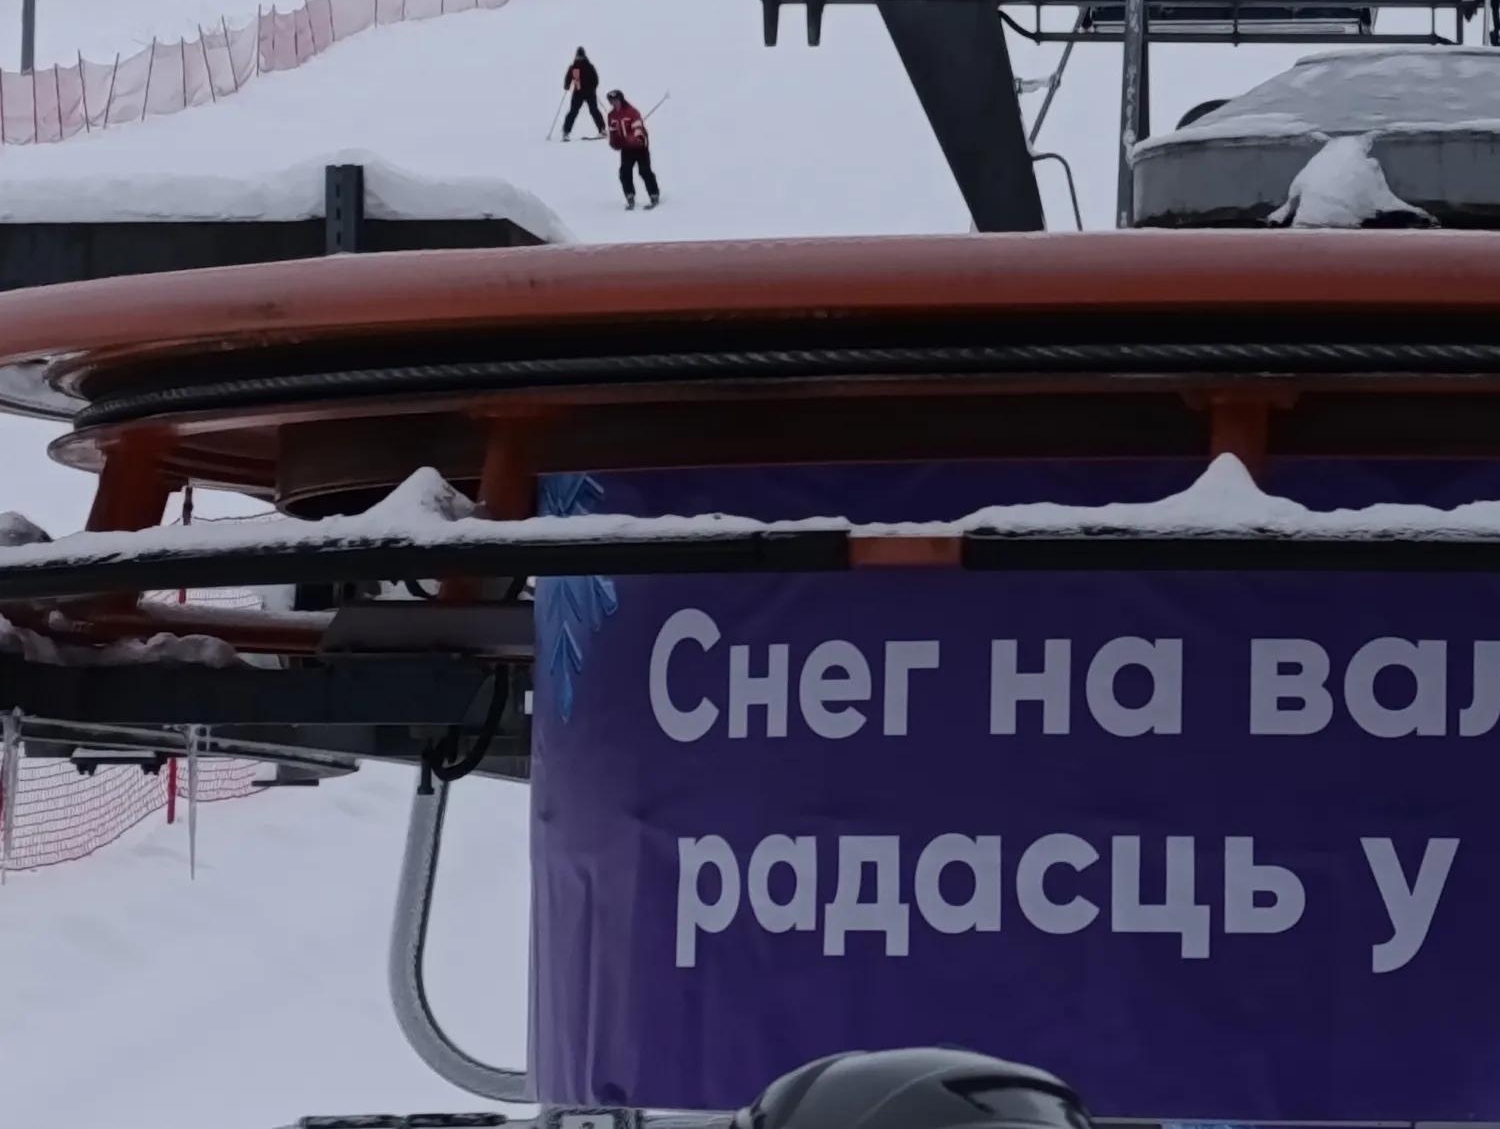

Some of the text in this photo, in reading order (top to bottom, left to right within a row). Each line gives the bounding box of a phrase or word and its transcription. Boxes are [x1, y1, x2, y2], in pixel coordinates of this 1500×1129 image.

[650, 608, 940, 742] Снег
[990, 636, 1183, 737] на
[675, 832, 1306, 968] радасць
[1360, 837, 1460, 973] у
